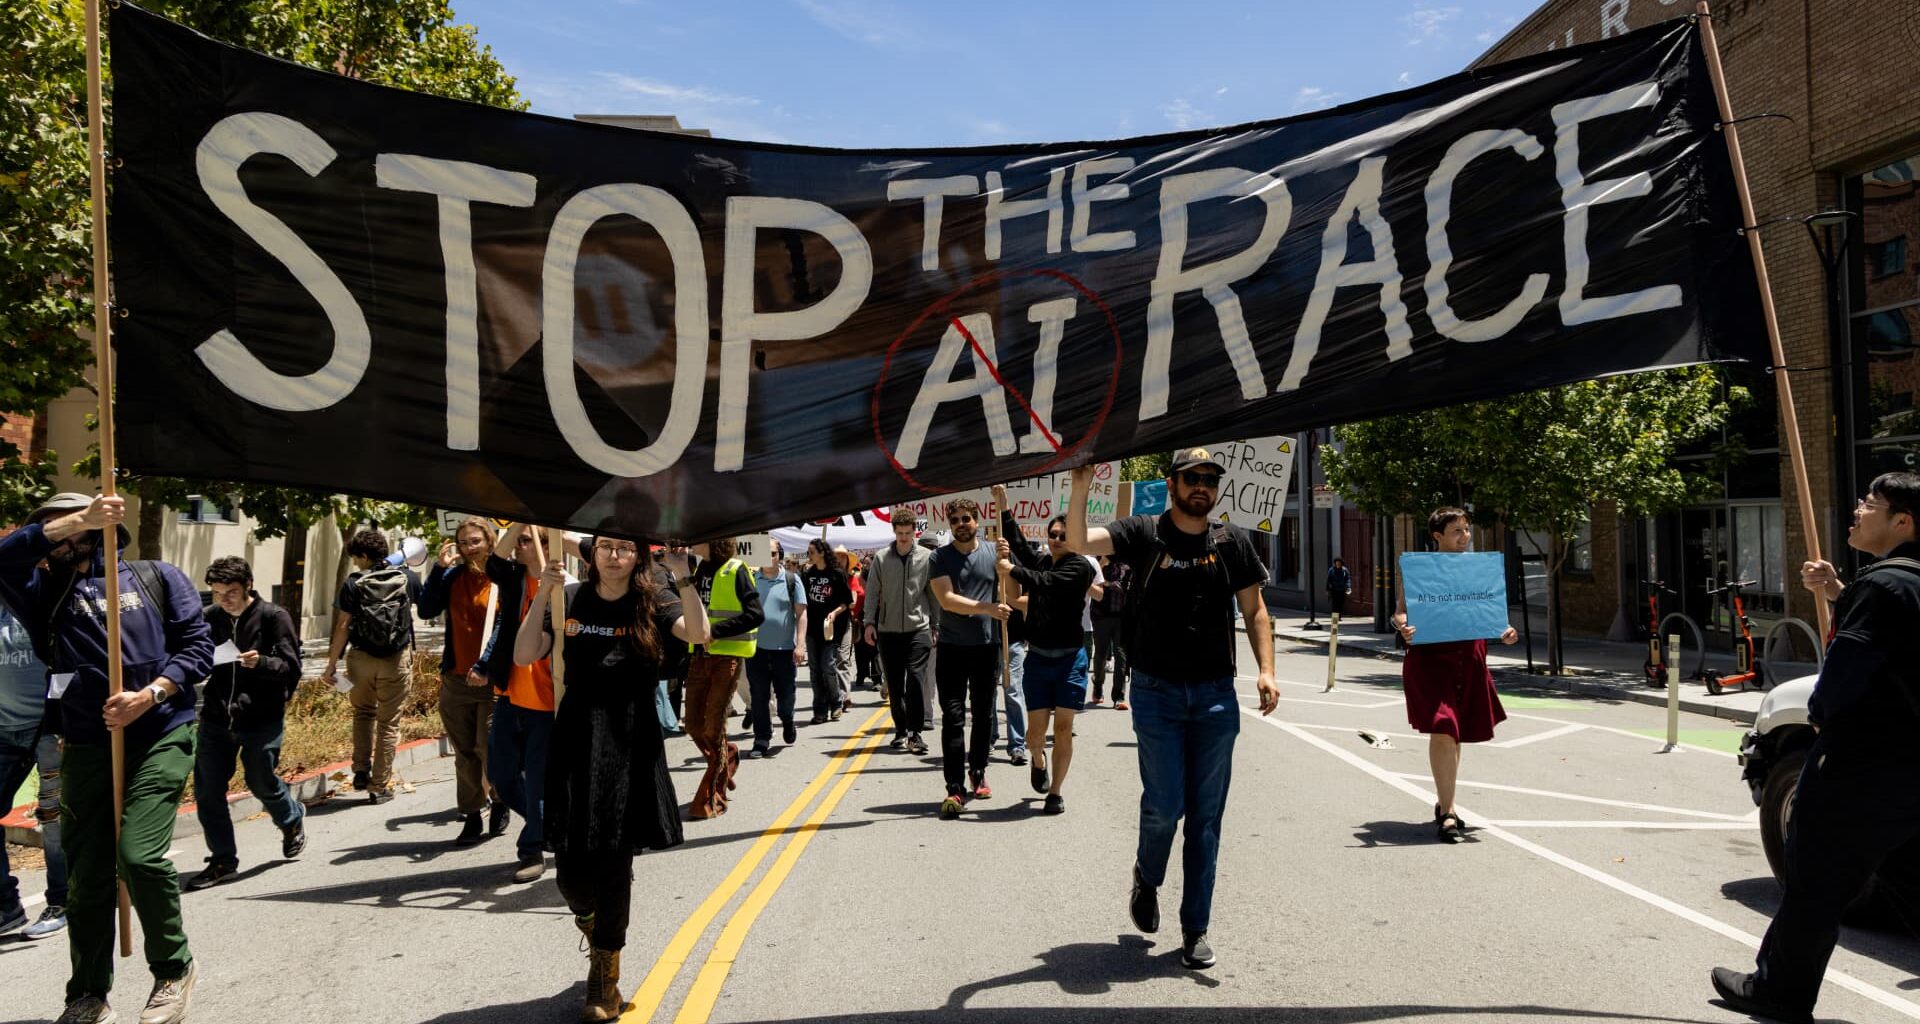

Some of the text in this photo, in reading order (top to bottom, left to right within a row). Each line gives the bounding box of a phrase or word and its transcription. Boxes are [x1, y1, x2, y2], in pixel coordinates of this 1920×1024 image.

[195, 82, 1683, 478] STOP THE RACE
[893, 298, 1076, 470] AI
[1240, 444, 1283, 478] Race
[1238, 482, 1282, 518] Cliff
[1428, 594, 1436, 603] is
[1438, 593, 1453, 603] not
